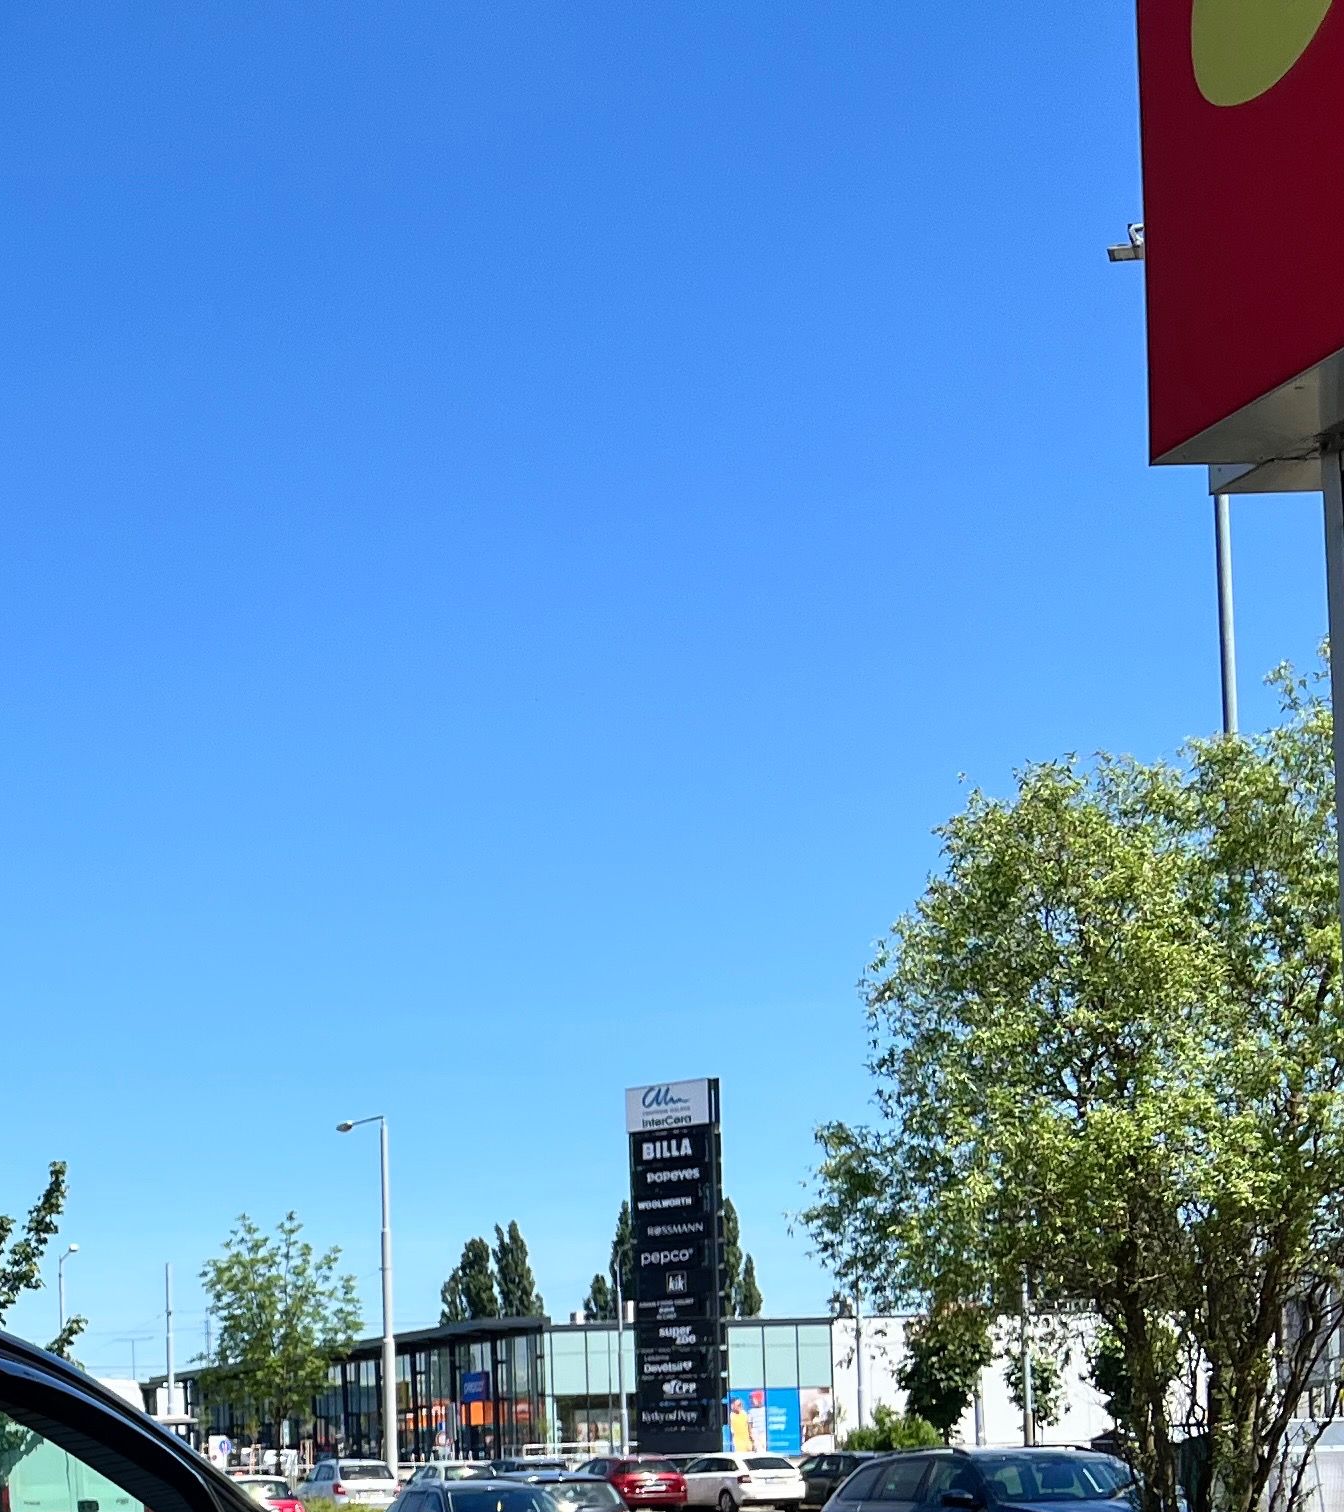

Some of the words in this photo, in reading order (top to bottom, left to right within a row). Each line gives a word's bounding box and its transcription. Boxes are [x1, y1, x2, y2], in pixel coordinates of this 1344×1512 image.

[642, 1137, 692, 1160] BILLA
[637, 1196, 692, 1210] WOOLWORTH
[647, 1222, 704, 1236] ROSSMANN
[640, 1248, 690, 1267] pepco
